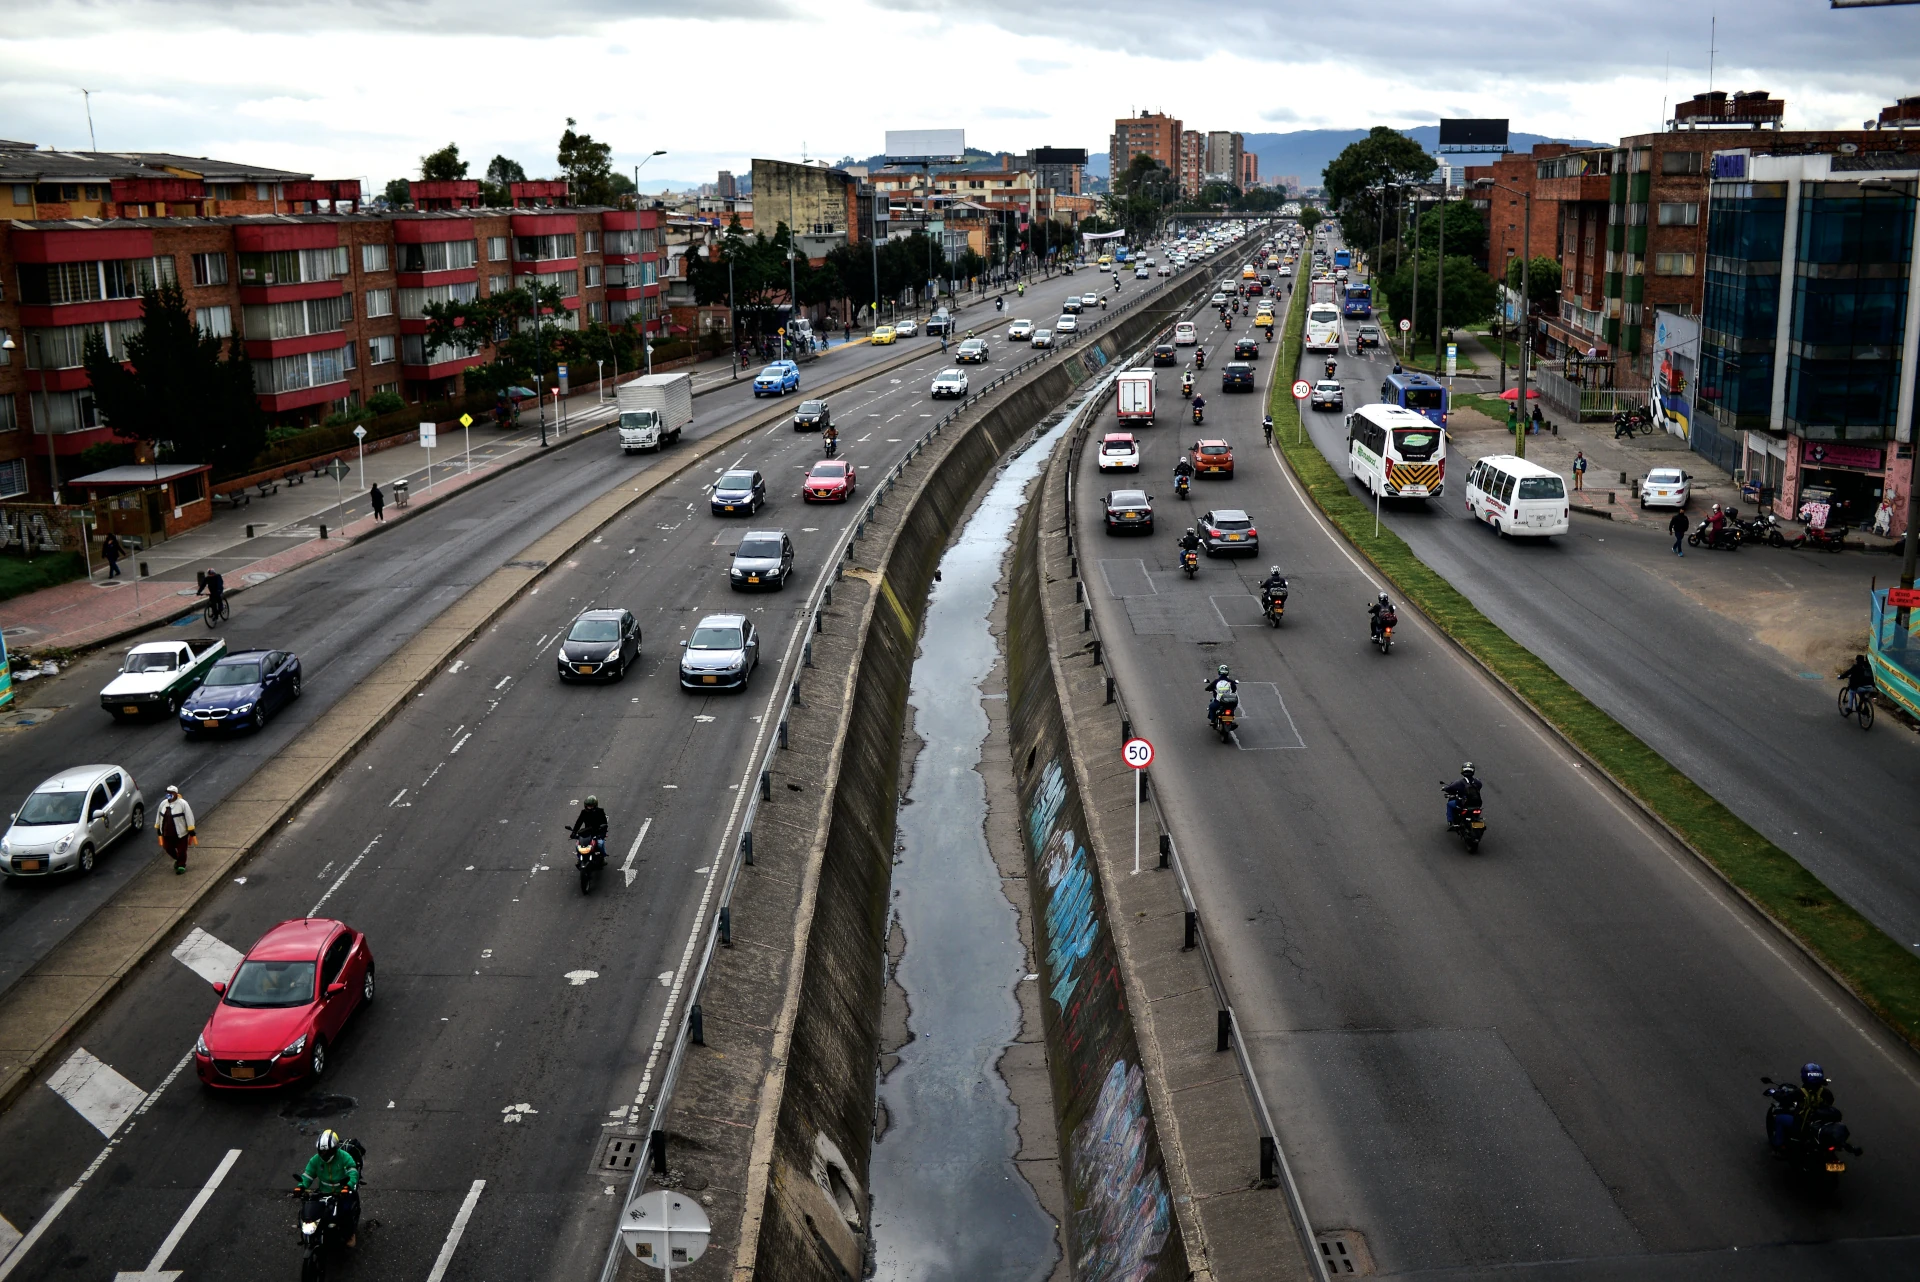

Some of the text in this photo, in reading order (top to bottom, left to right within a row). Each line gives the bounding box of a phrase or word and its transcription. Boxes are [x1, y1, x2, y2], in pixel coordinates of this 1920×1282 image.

[1402, 321, 1409, 329] 50
[1296, 385, 1308, 394] 50
[1129, 746, 1148, 760] 50
